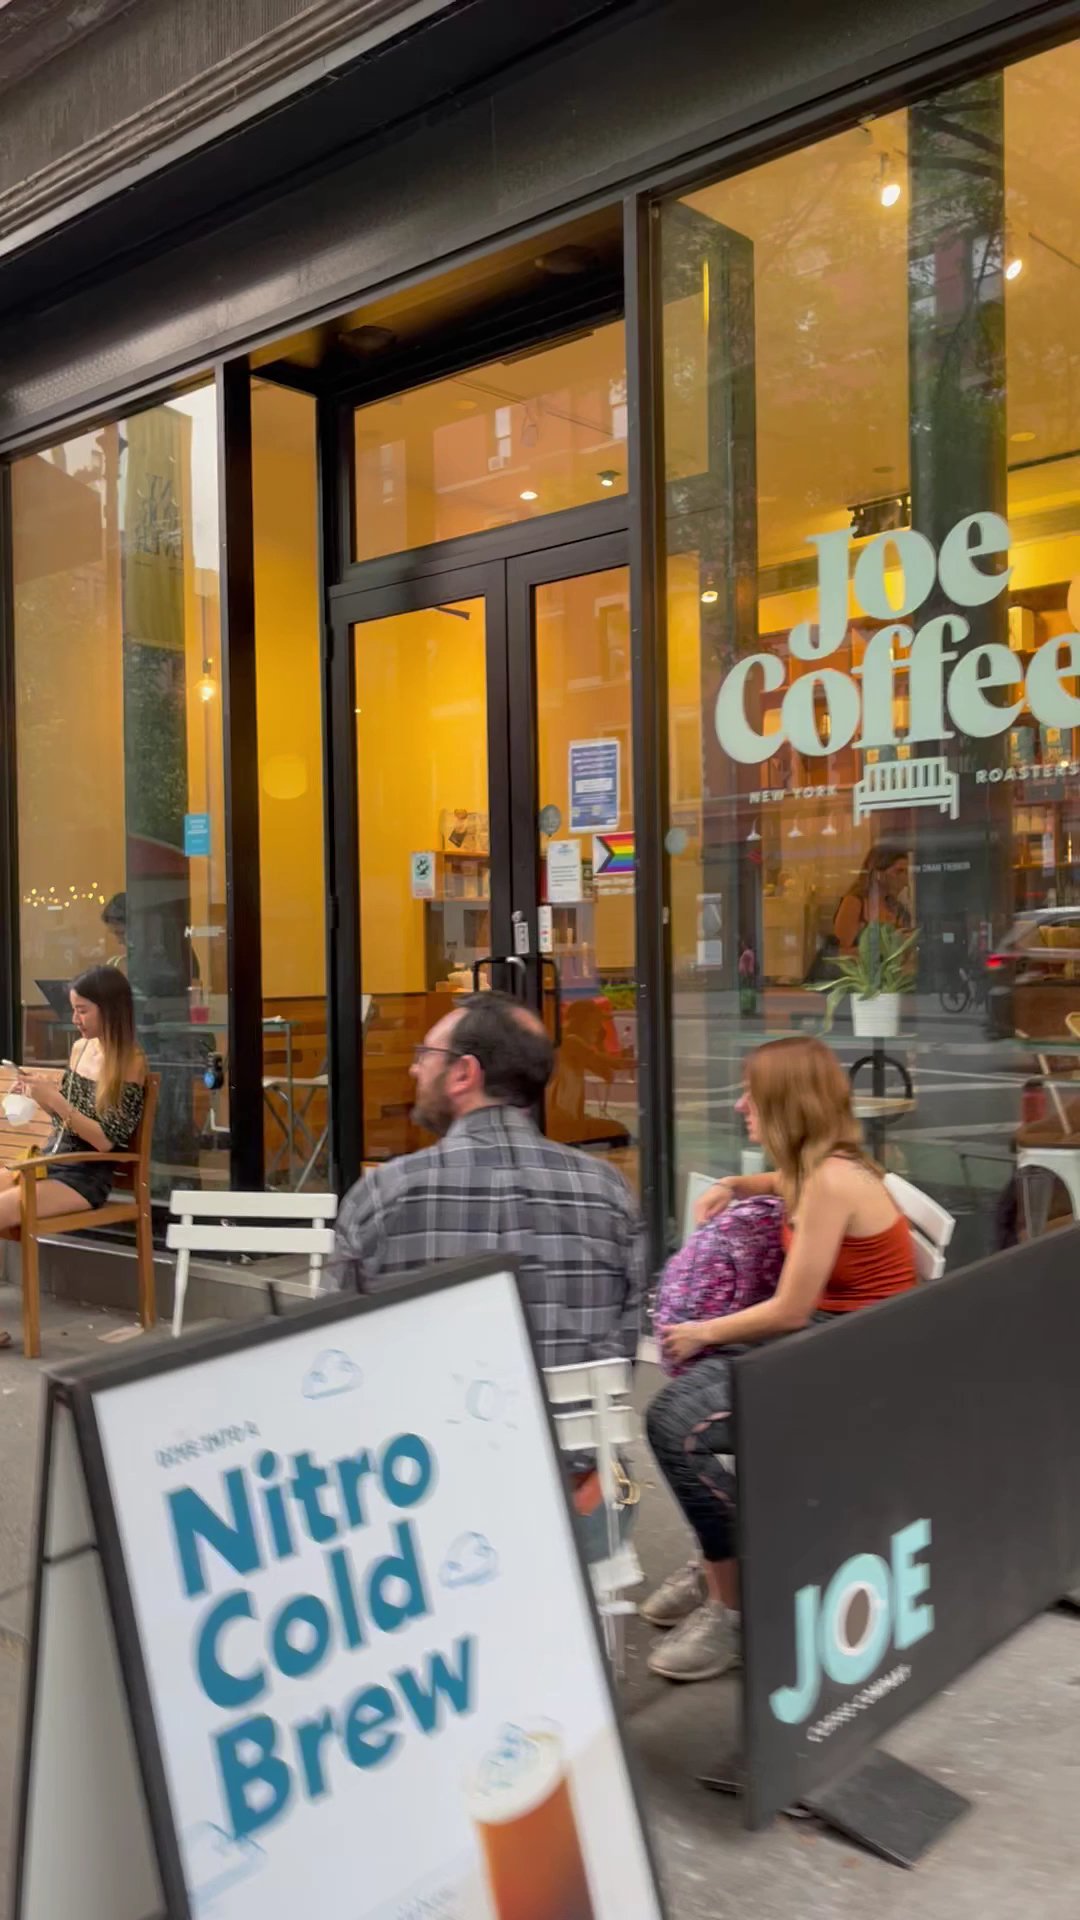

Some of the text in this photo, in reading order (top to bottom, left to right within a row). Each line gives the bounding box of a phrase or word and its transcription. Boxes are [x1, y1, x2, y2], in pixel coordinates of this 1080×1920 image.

[788, 511, 1013, 660] Joe
[715, 615, 1080, 764] Coffee
[749, 784, 837, 804] NEW YORK
[975, 761, 1079, 784] ROASTERS
[166, 1432, 434, 1595] Nitro
[195, 1520, 430, 1708] Cold
[768, 1517, 934, 1724] JOE
[212, 1637, 476, 1840] Brew
